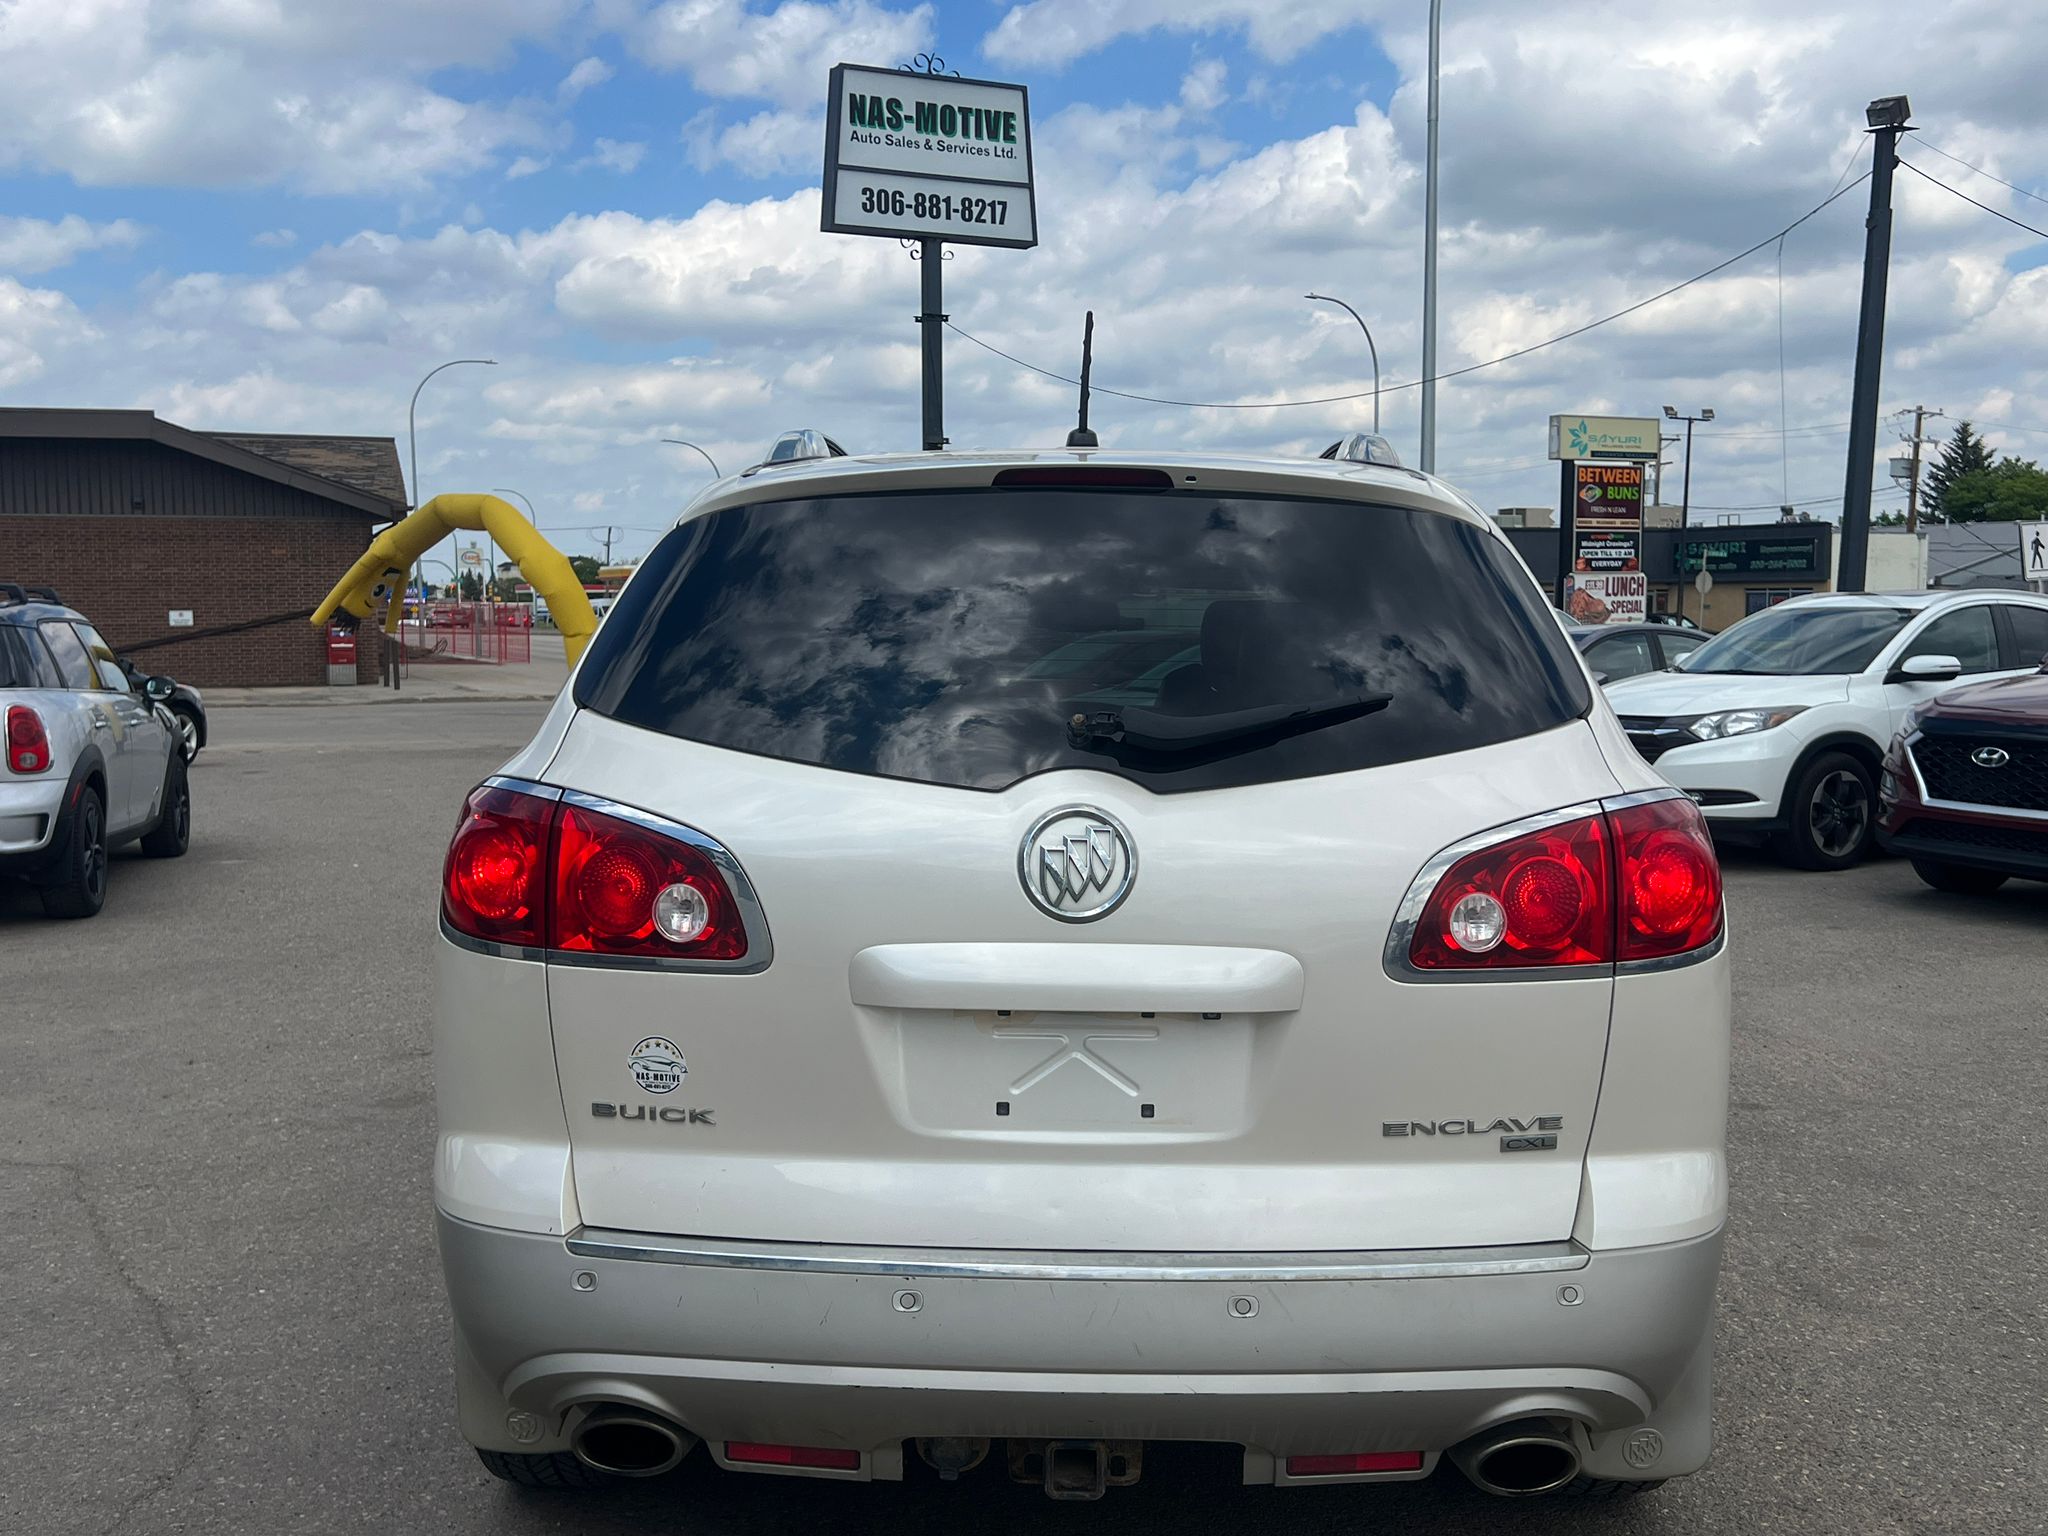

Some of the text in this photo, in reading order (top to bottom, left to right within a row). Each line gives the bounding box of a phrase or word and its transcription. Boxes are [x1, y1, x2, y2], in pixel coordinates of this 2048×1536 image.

[849, 92, 1017, 144] NAS-MOTIVE
[850, 130, 1017, 159] Auto Sales & Services Ltd.
[861, 187, 1008, 226] 306-881-8217
[1588, 434, 1642, 446] SAYURI
[1578, 467, 1640, 484] BETWEEN
[1607, 486, 1639, 500] BUNS
[1605, 576, 1644, 597] LUNCH
[1610, 600, 1643, 614] SPECIAL
[636, 1072, 680, 1083] NAS-MOTIVE
[592, 1102, 717, 1126] BUICK
[1382, 1114, 1563, 1137] ENCLAVE
[1506, 1137, 1555, 1149] CXL
